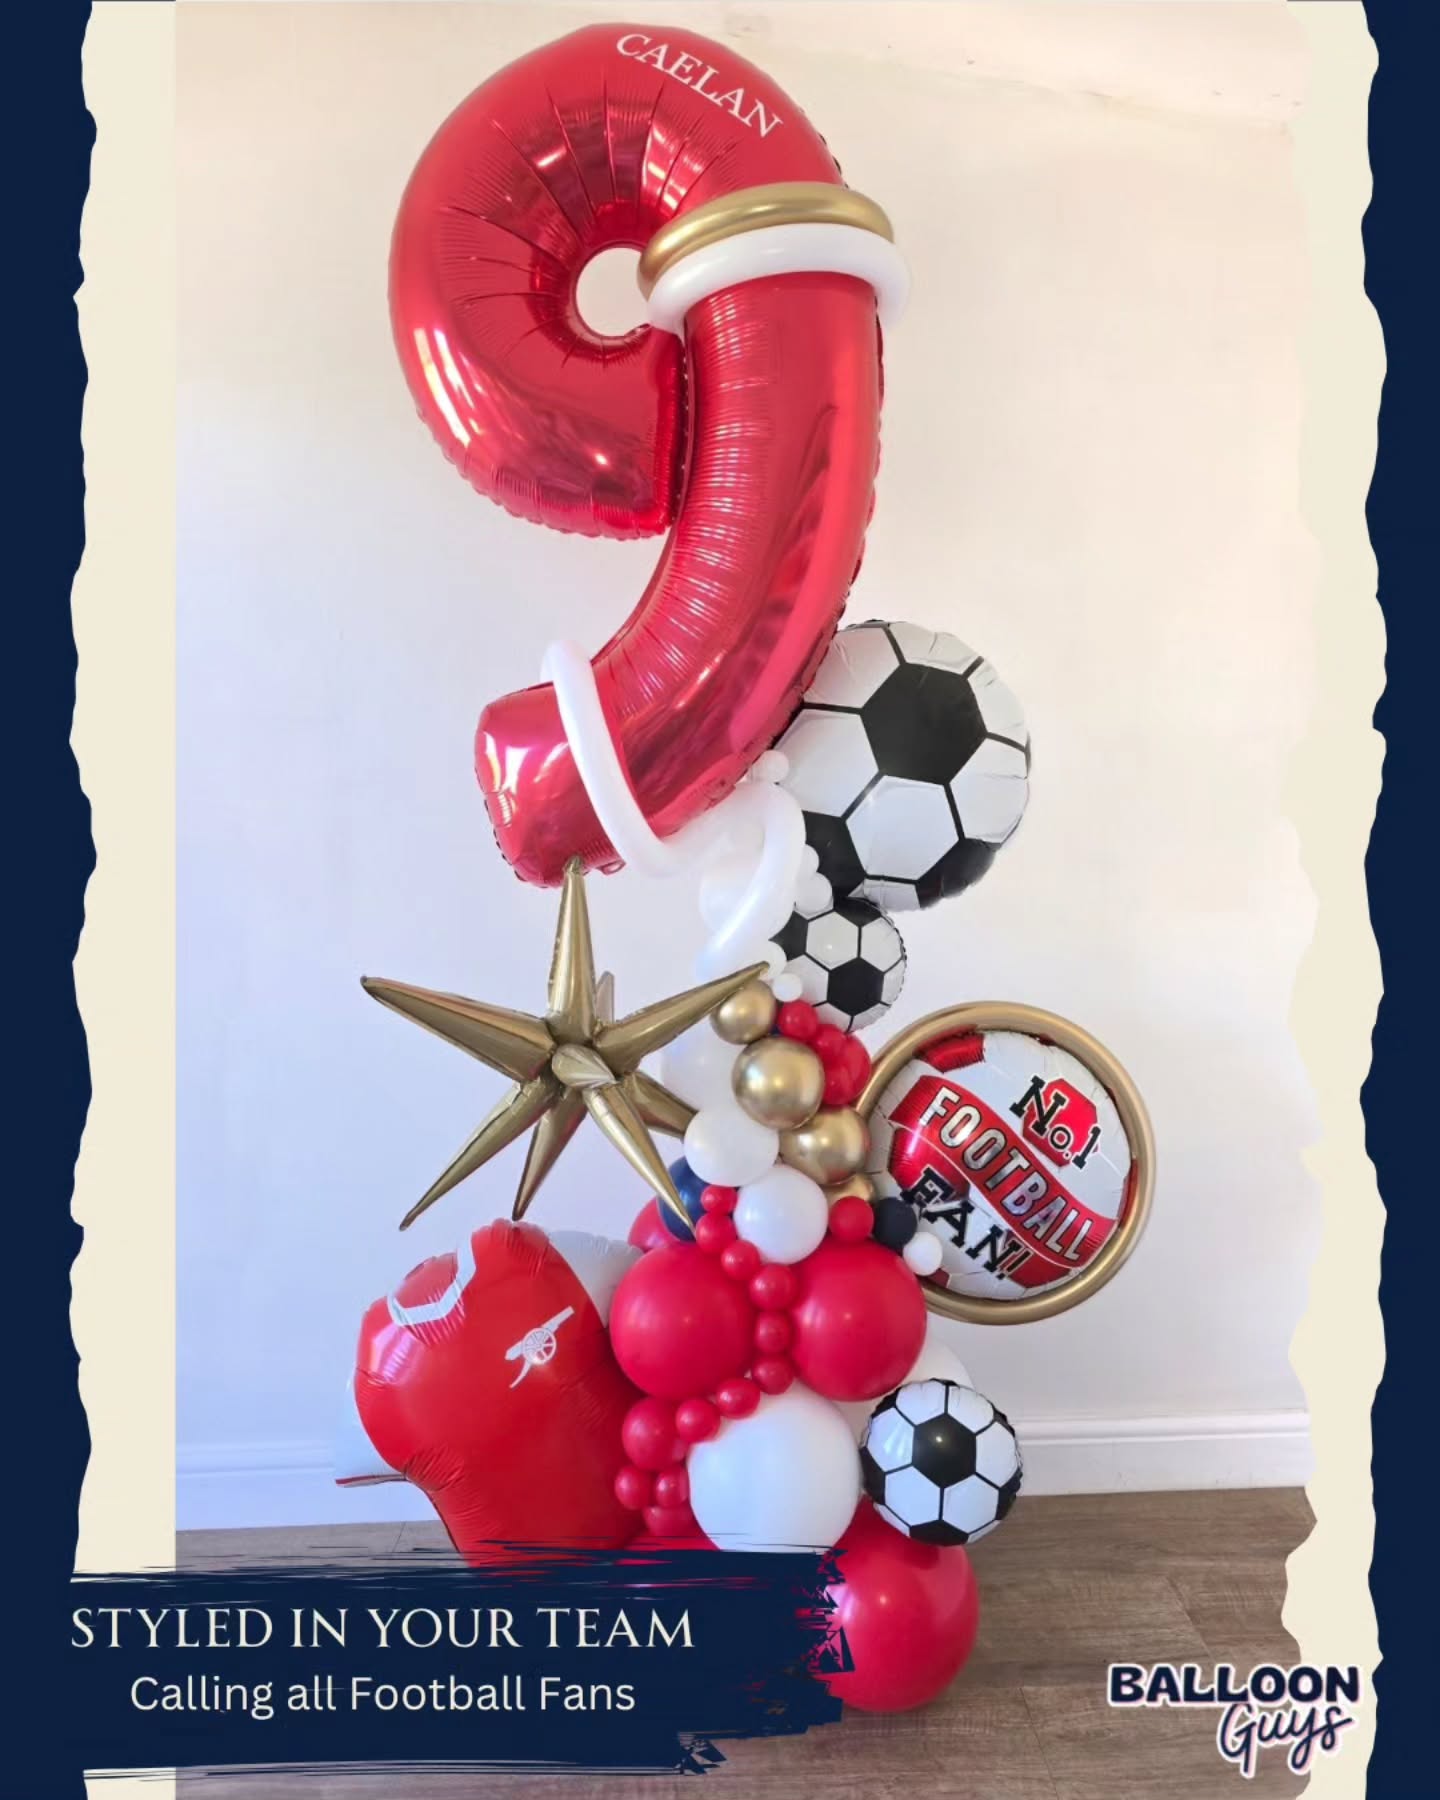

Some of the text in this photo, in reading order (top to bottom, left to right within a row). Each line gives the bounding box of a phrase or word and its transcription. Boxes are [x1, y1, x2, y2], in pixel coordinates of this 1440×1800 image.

[616, 33, 784, 138] CAELAN
[900, 1167, 1034, 1280] FAN!
[919, 1086, 1094, 1262] FOOTBALL
